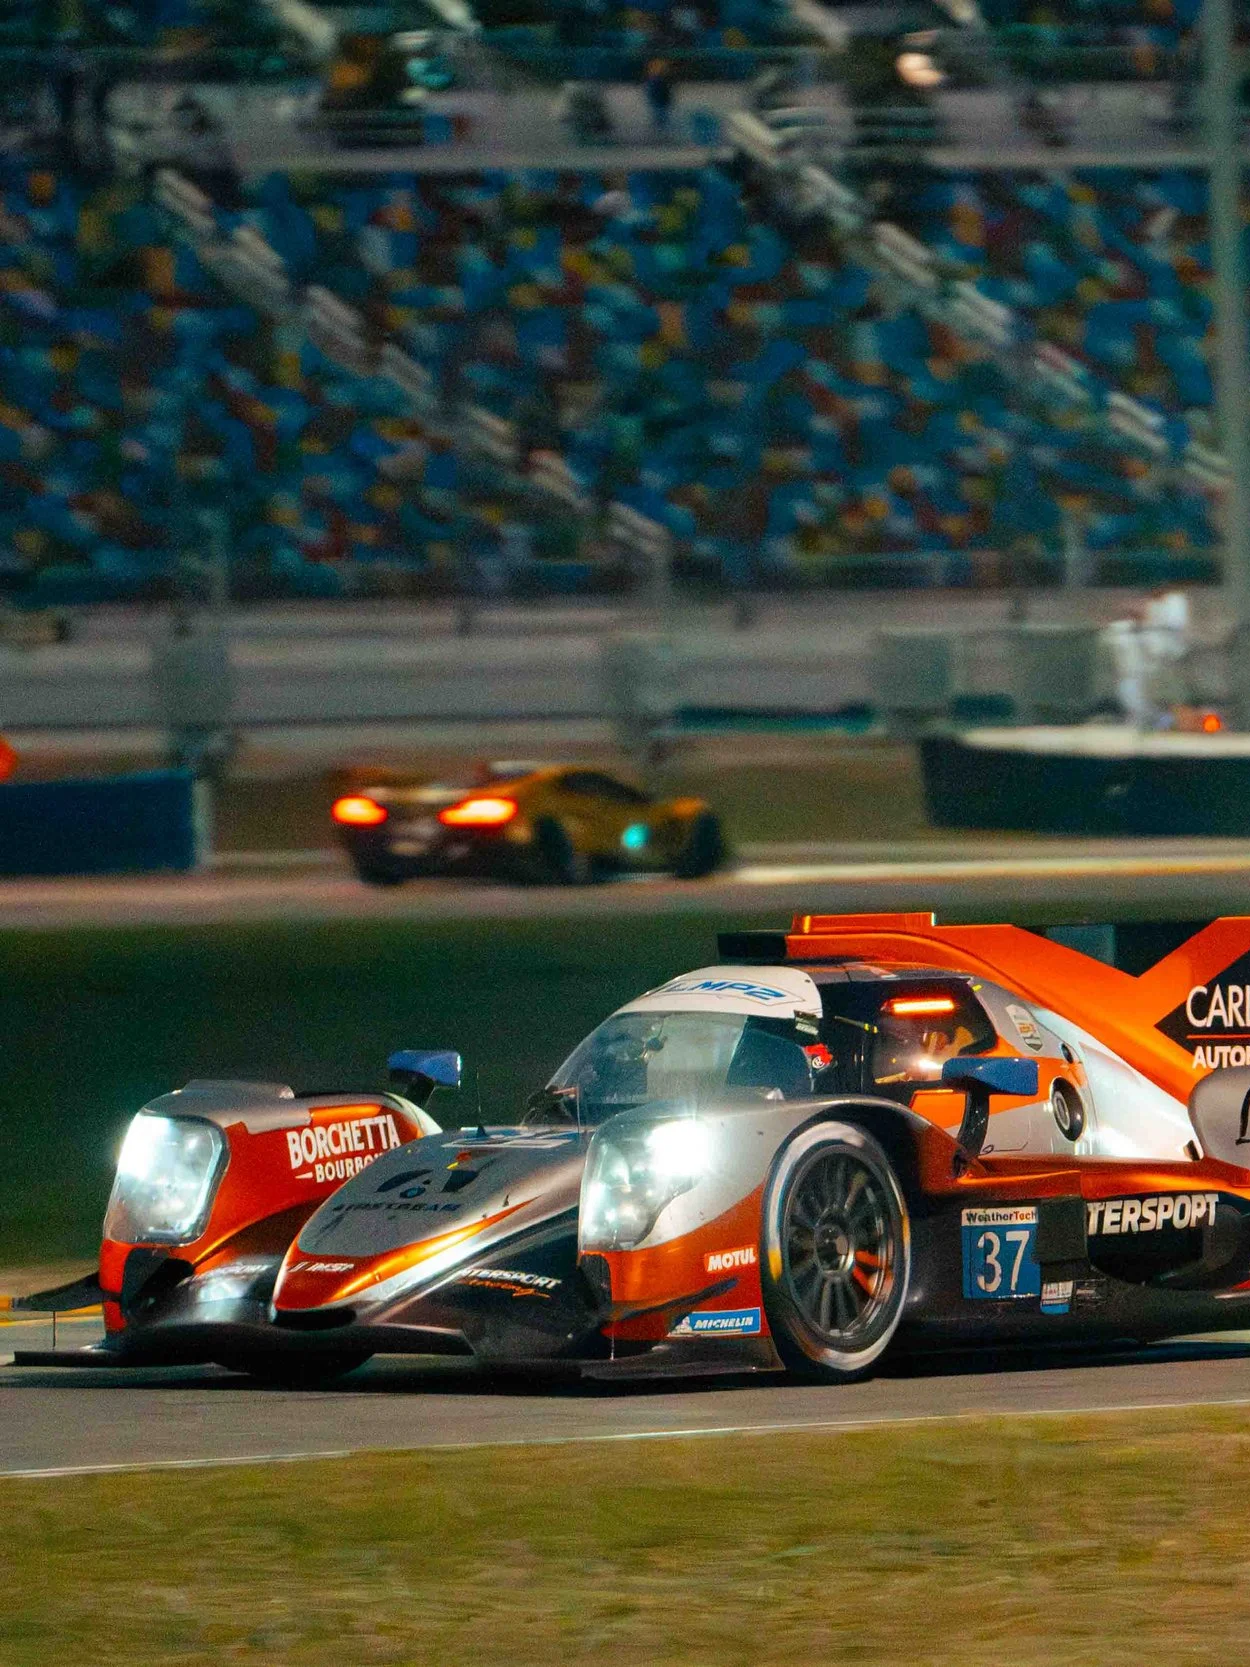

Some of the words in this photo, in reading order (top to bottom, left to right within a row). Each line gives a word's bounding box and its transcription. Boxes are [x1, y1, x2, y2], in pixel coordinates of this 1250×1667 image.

[286, 1114, 401, 1170] BORCHETTA
[315, 1152, 385, 1183] BOURB
[966, 1210, 1036, 1223] WeatherTech
[707, 1247, 757, 1272] MOTUL
[977, 1230, 1030, 1293] 37
[694, 1316, 754, 1330] MICHELIN
